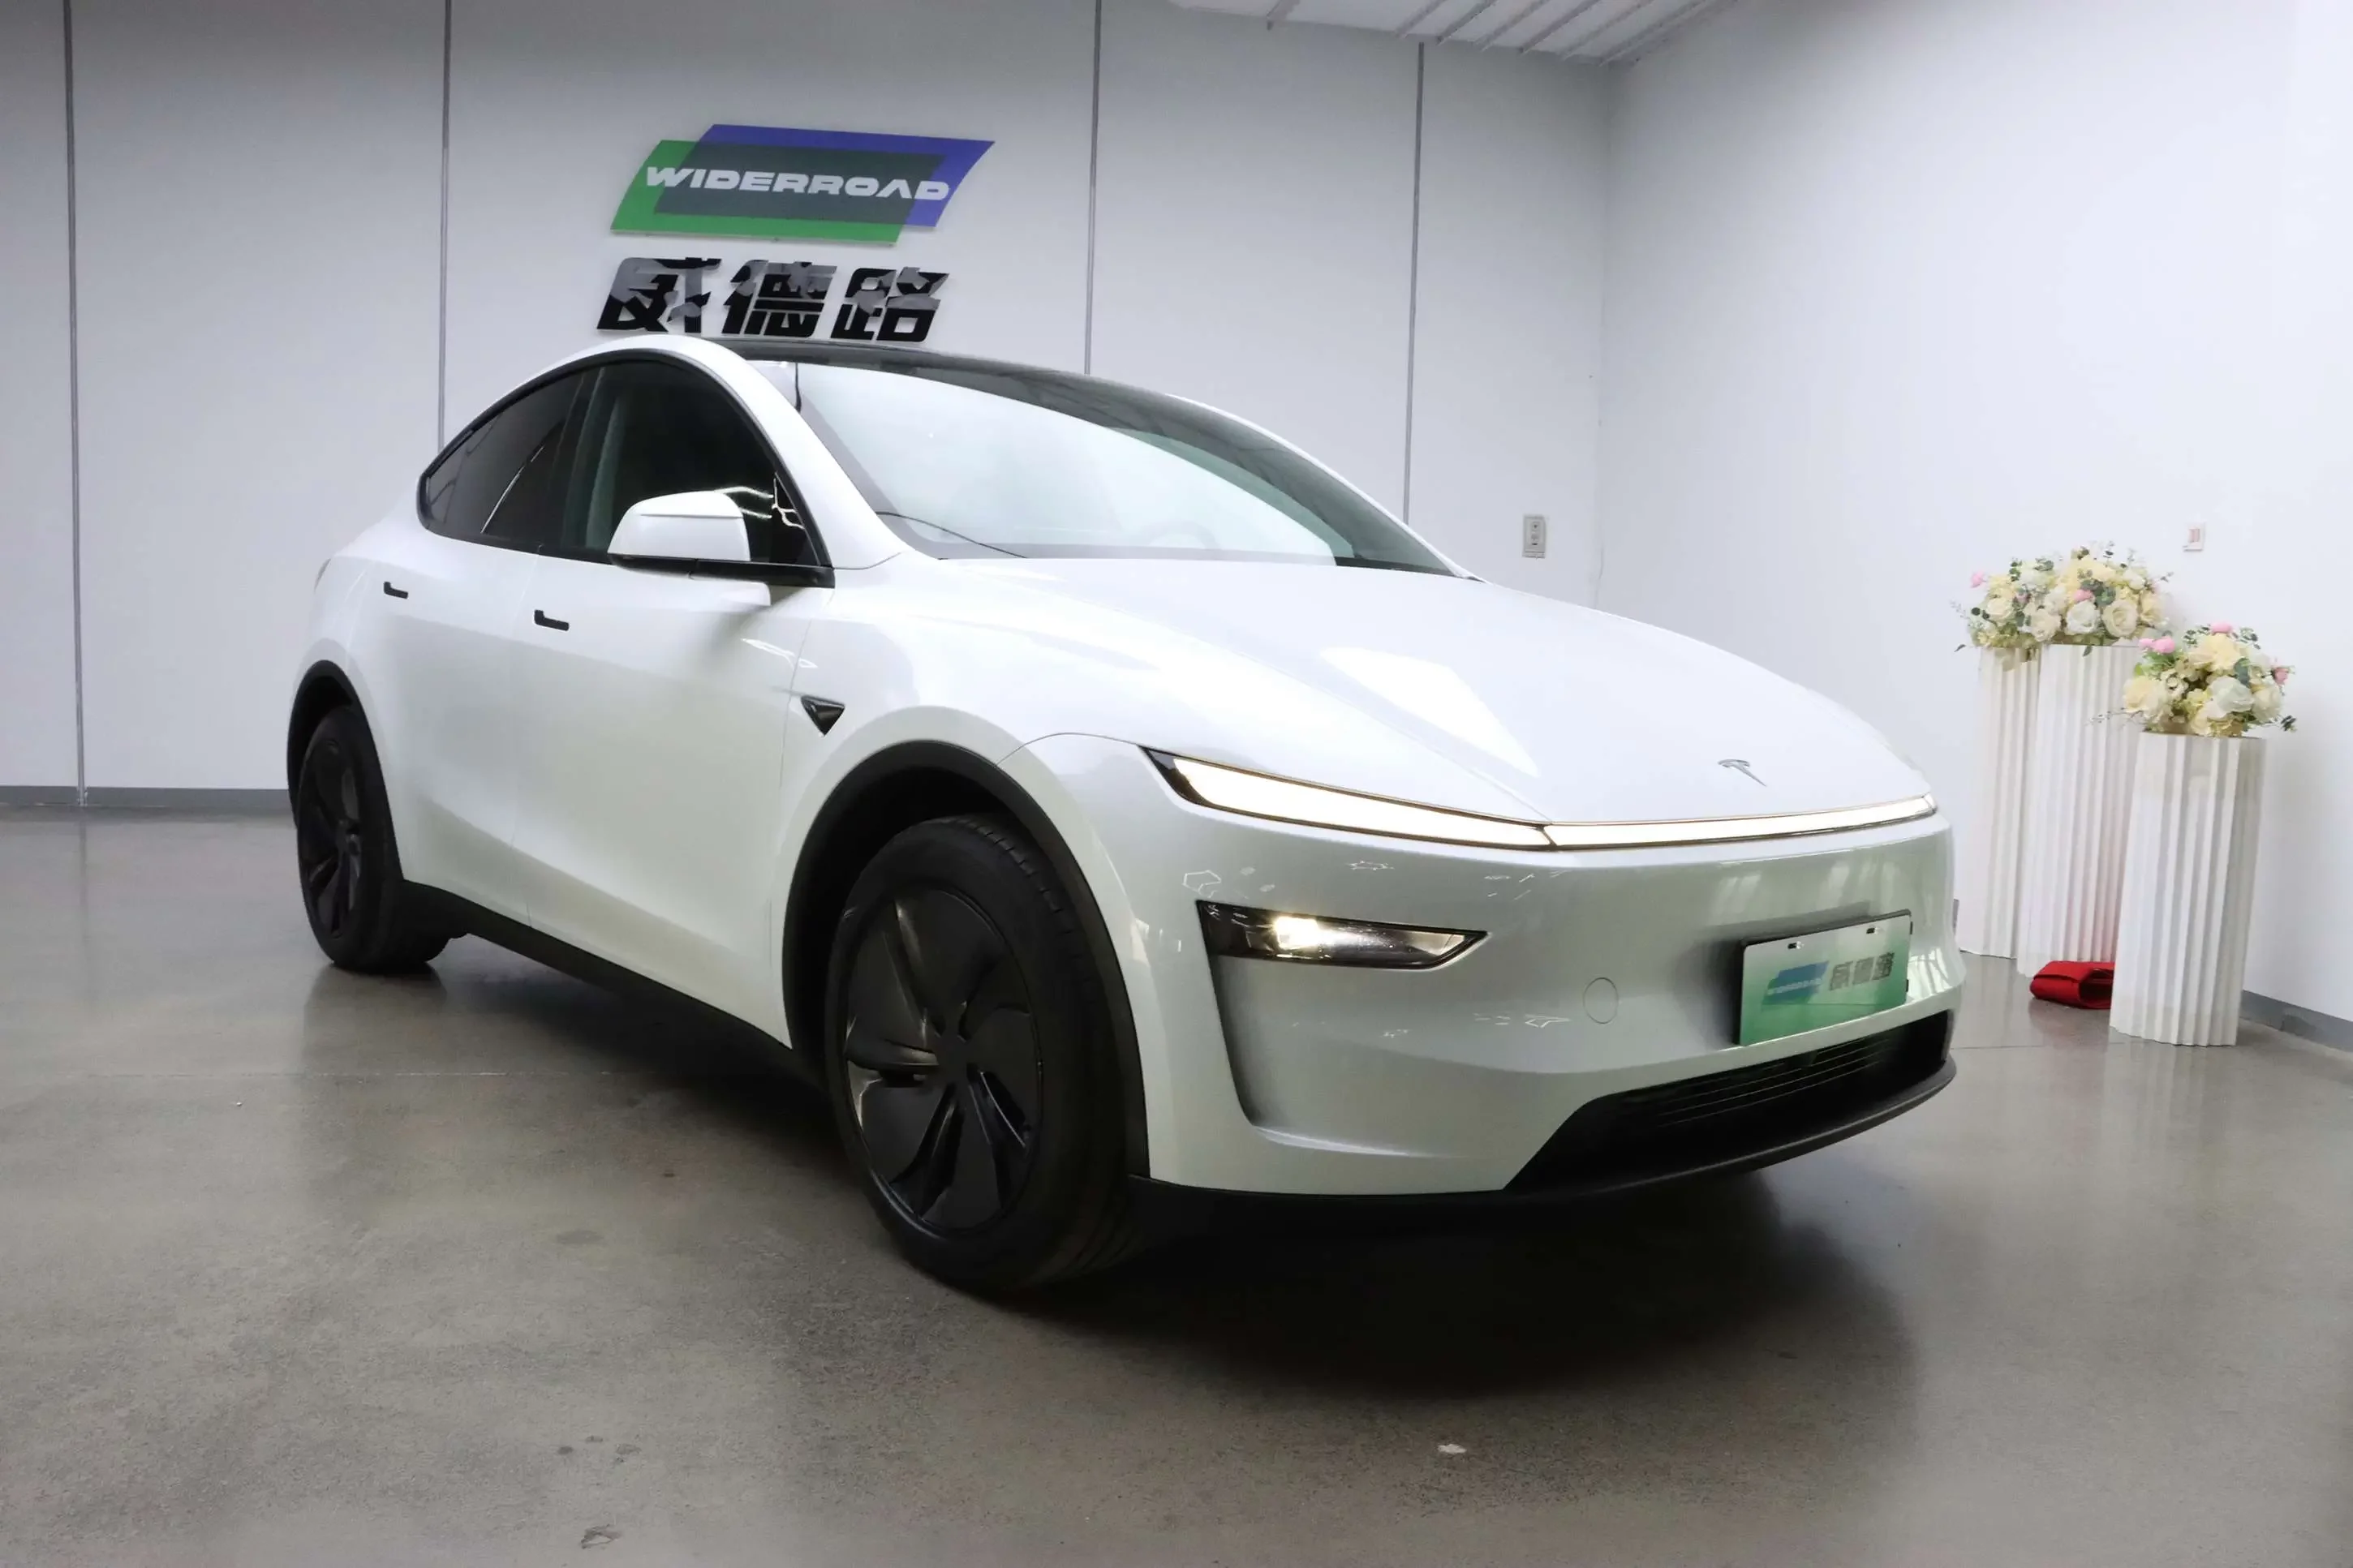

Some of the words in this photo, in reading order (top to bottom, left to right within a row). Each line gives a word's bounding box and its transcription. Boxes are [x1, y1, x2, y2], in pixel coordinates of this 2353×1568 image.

[647, 165, 949, 200] WIDERROAD
[597, 256, 949, 342] 威德路
